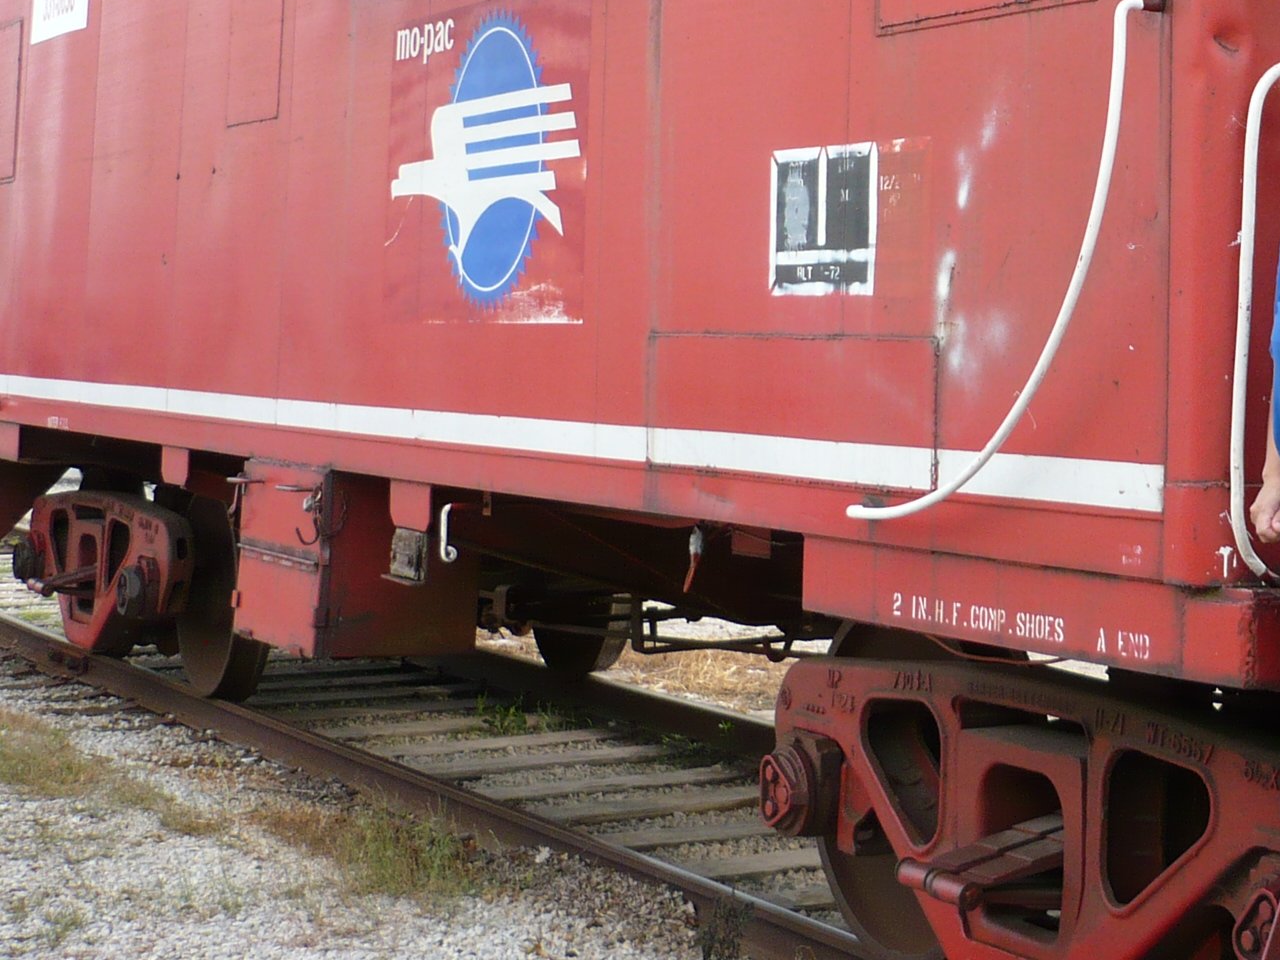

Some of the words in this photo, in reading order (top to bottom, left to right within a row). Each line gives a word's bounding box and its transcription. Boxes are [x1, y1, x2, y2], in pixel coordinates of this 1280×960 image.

[893, 592, 902, 617] 2
[1097, 626, 1106, 653] A
[1118, 630, 1150, 659] END
